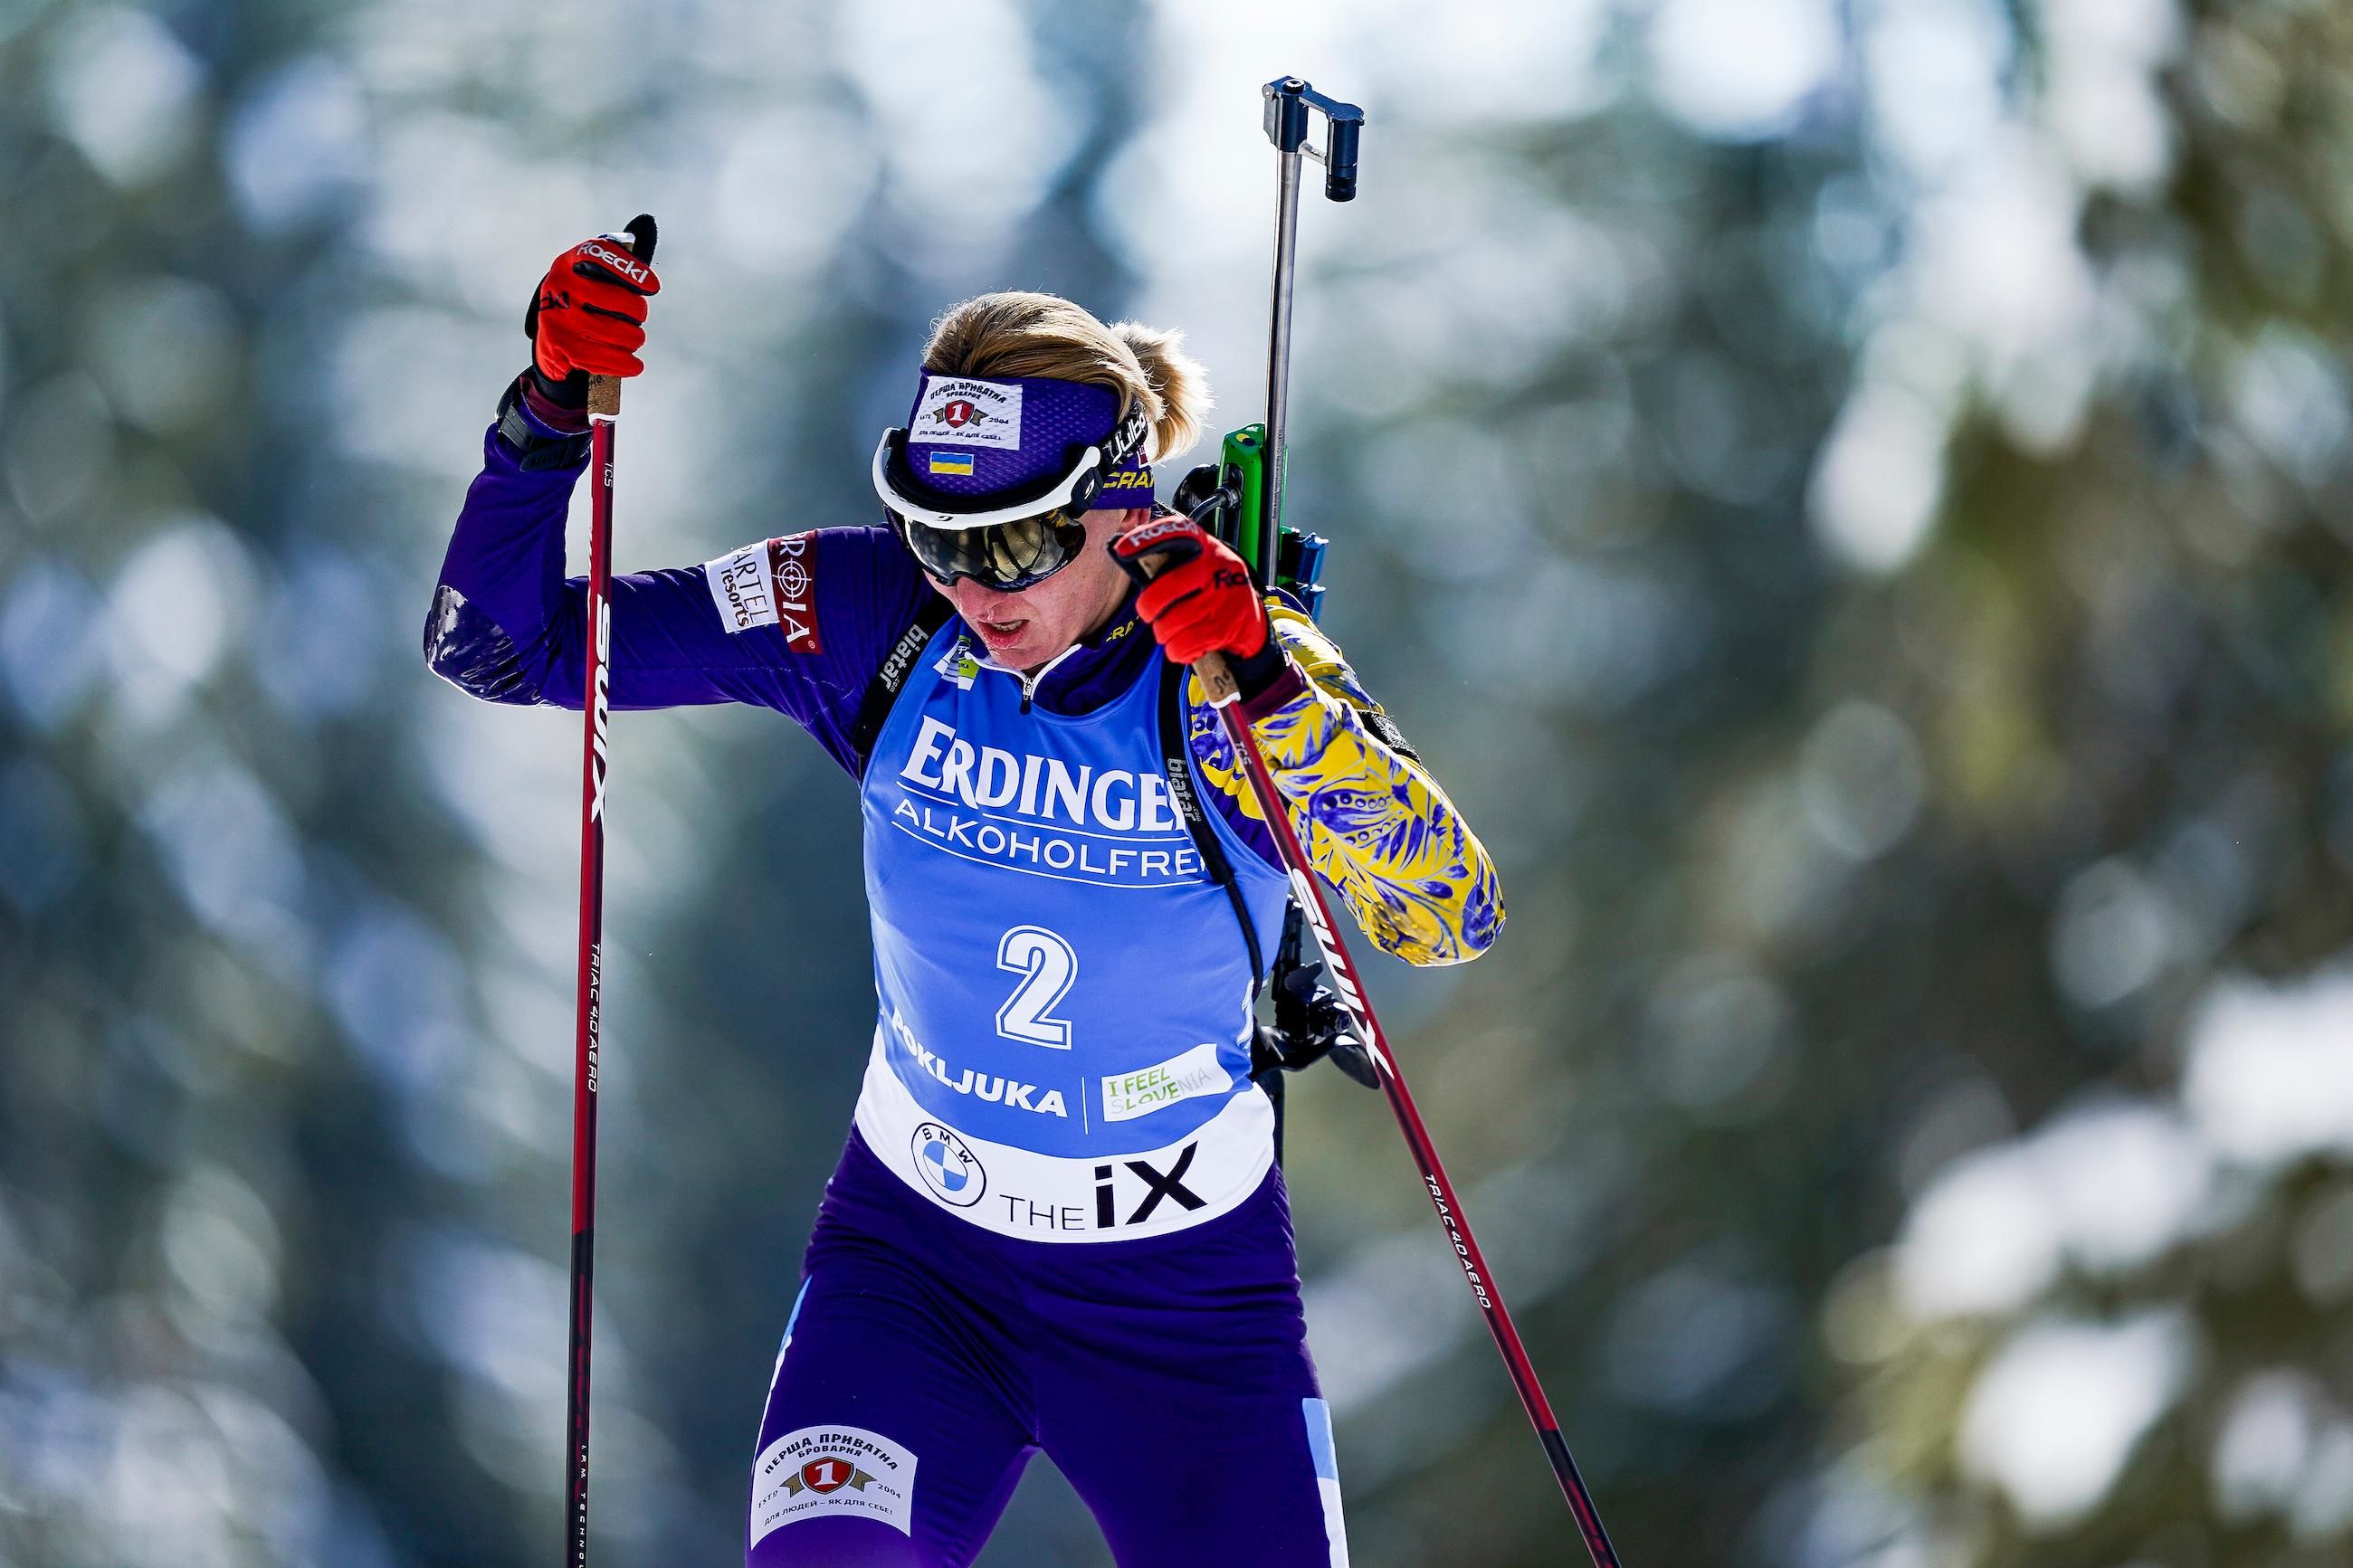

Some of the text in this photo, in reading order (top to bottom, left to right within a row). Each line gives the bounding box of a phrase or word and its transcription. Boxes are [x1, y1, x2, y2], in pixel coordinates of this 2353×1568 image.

[930, 383, 1006, 404] ПЕРША ПРИВАТНА
[948, 404, 964, 422] 1
[720, 568, 749, 627] resorts
[590, 944, 600, 1002] TRIAC
[996, 925, 1079, 1050] 2
[588, 1035, 598, 1093] AERO
[891, 1005, 1068, 1118] POKLJUKA
[1109, 1067, 1170, 1097] I FEEL
[922, 1127, 973, 1164] BMW
[999, 1140, 1208, 1231] THE iX
[1425, 1174, 1456, 1228] TRIAC
[1461, 1258, 1491, 1308] AERO
[765, 1433, 898, 1475] ПЕРША ПРИВАТНА
[797, 1446, 862, 1459] БРОВАРНЯ
[814, 1462, 839, 1487] 1
[878, 1483, 901, 1499] 2004
[764, 1512, 780, 1526] ДЛЯ
[782, 1500, 817, 1516] ЛЮДЕЙ
[844, 1498, 865, 1506] ДЛЯ
[868, 1502, 893, 1516] СЕБЕ!
